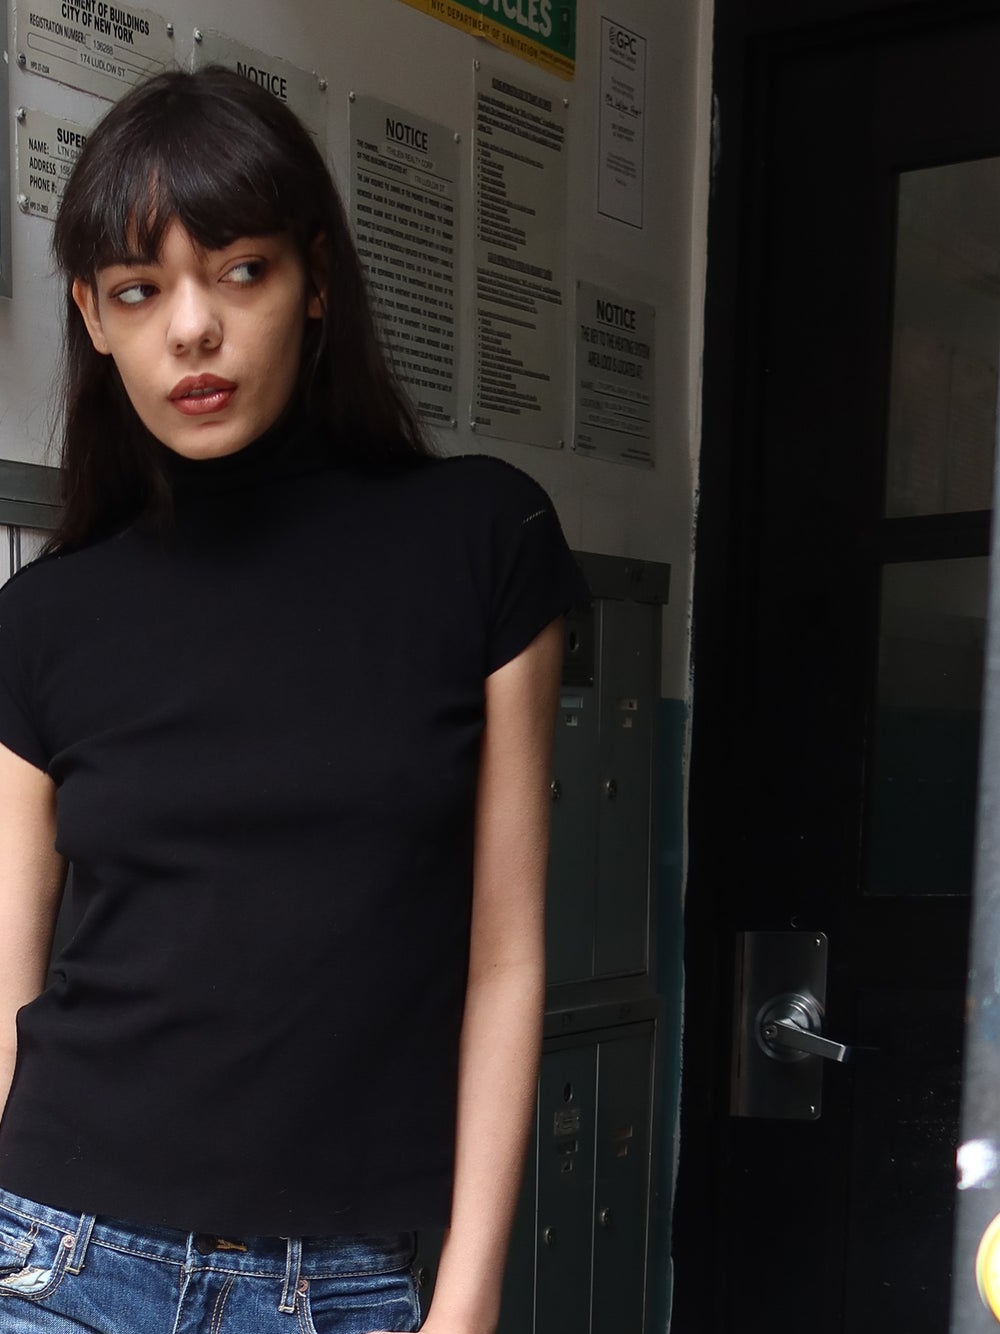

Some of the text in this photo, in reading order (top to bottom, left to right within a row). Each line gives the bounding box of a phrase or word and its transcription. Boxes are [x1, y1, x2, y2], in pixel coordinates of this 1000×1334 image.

[29, 13, 63, 37] REGISTRATION
[61, 3, 134, 45] CITY OF NEW YORK
[98, 2, 108, 18] OF
[110, 7, 150, 36] BUILDINGS
[431, 0, 445, 14] NYC
[447, 6, 490, 33] DEPARTMENT
[502, 33, 539, 58] SANITATION
[616, 31, 637, 55] GPC
[79, 53, 127, 77] 174 LUDLOW ST
[236, 61, 287, 99] NOTICE
[28, 137, 50, 155] NAME:
[386, 117, 429, 151] NOTICE
[29, 156, 57, 176] ADDRESS
[30, 175, 51, 192] PHONE
[596, 299, 636, 330] NOTICE
